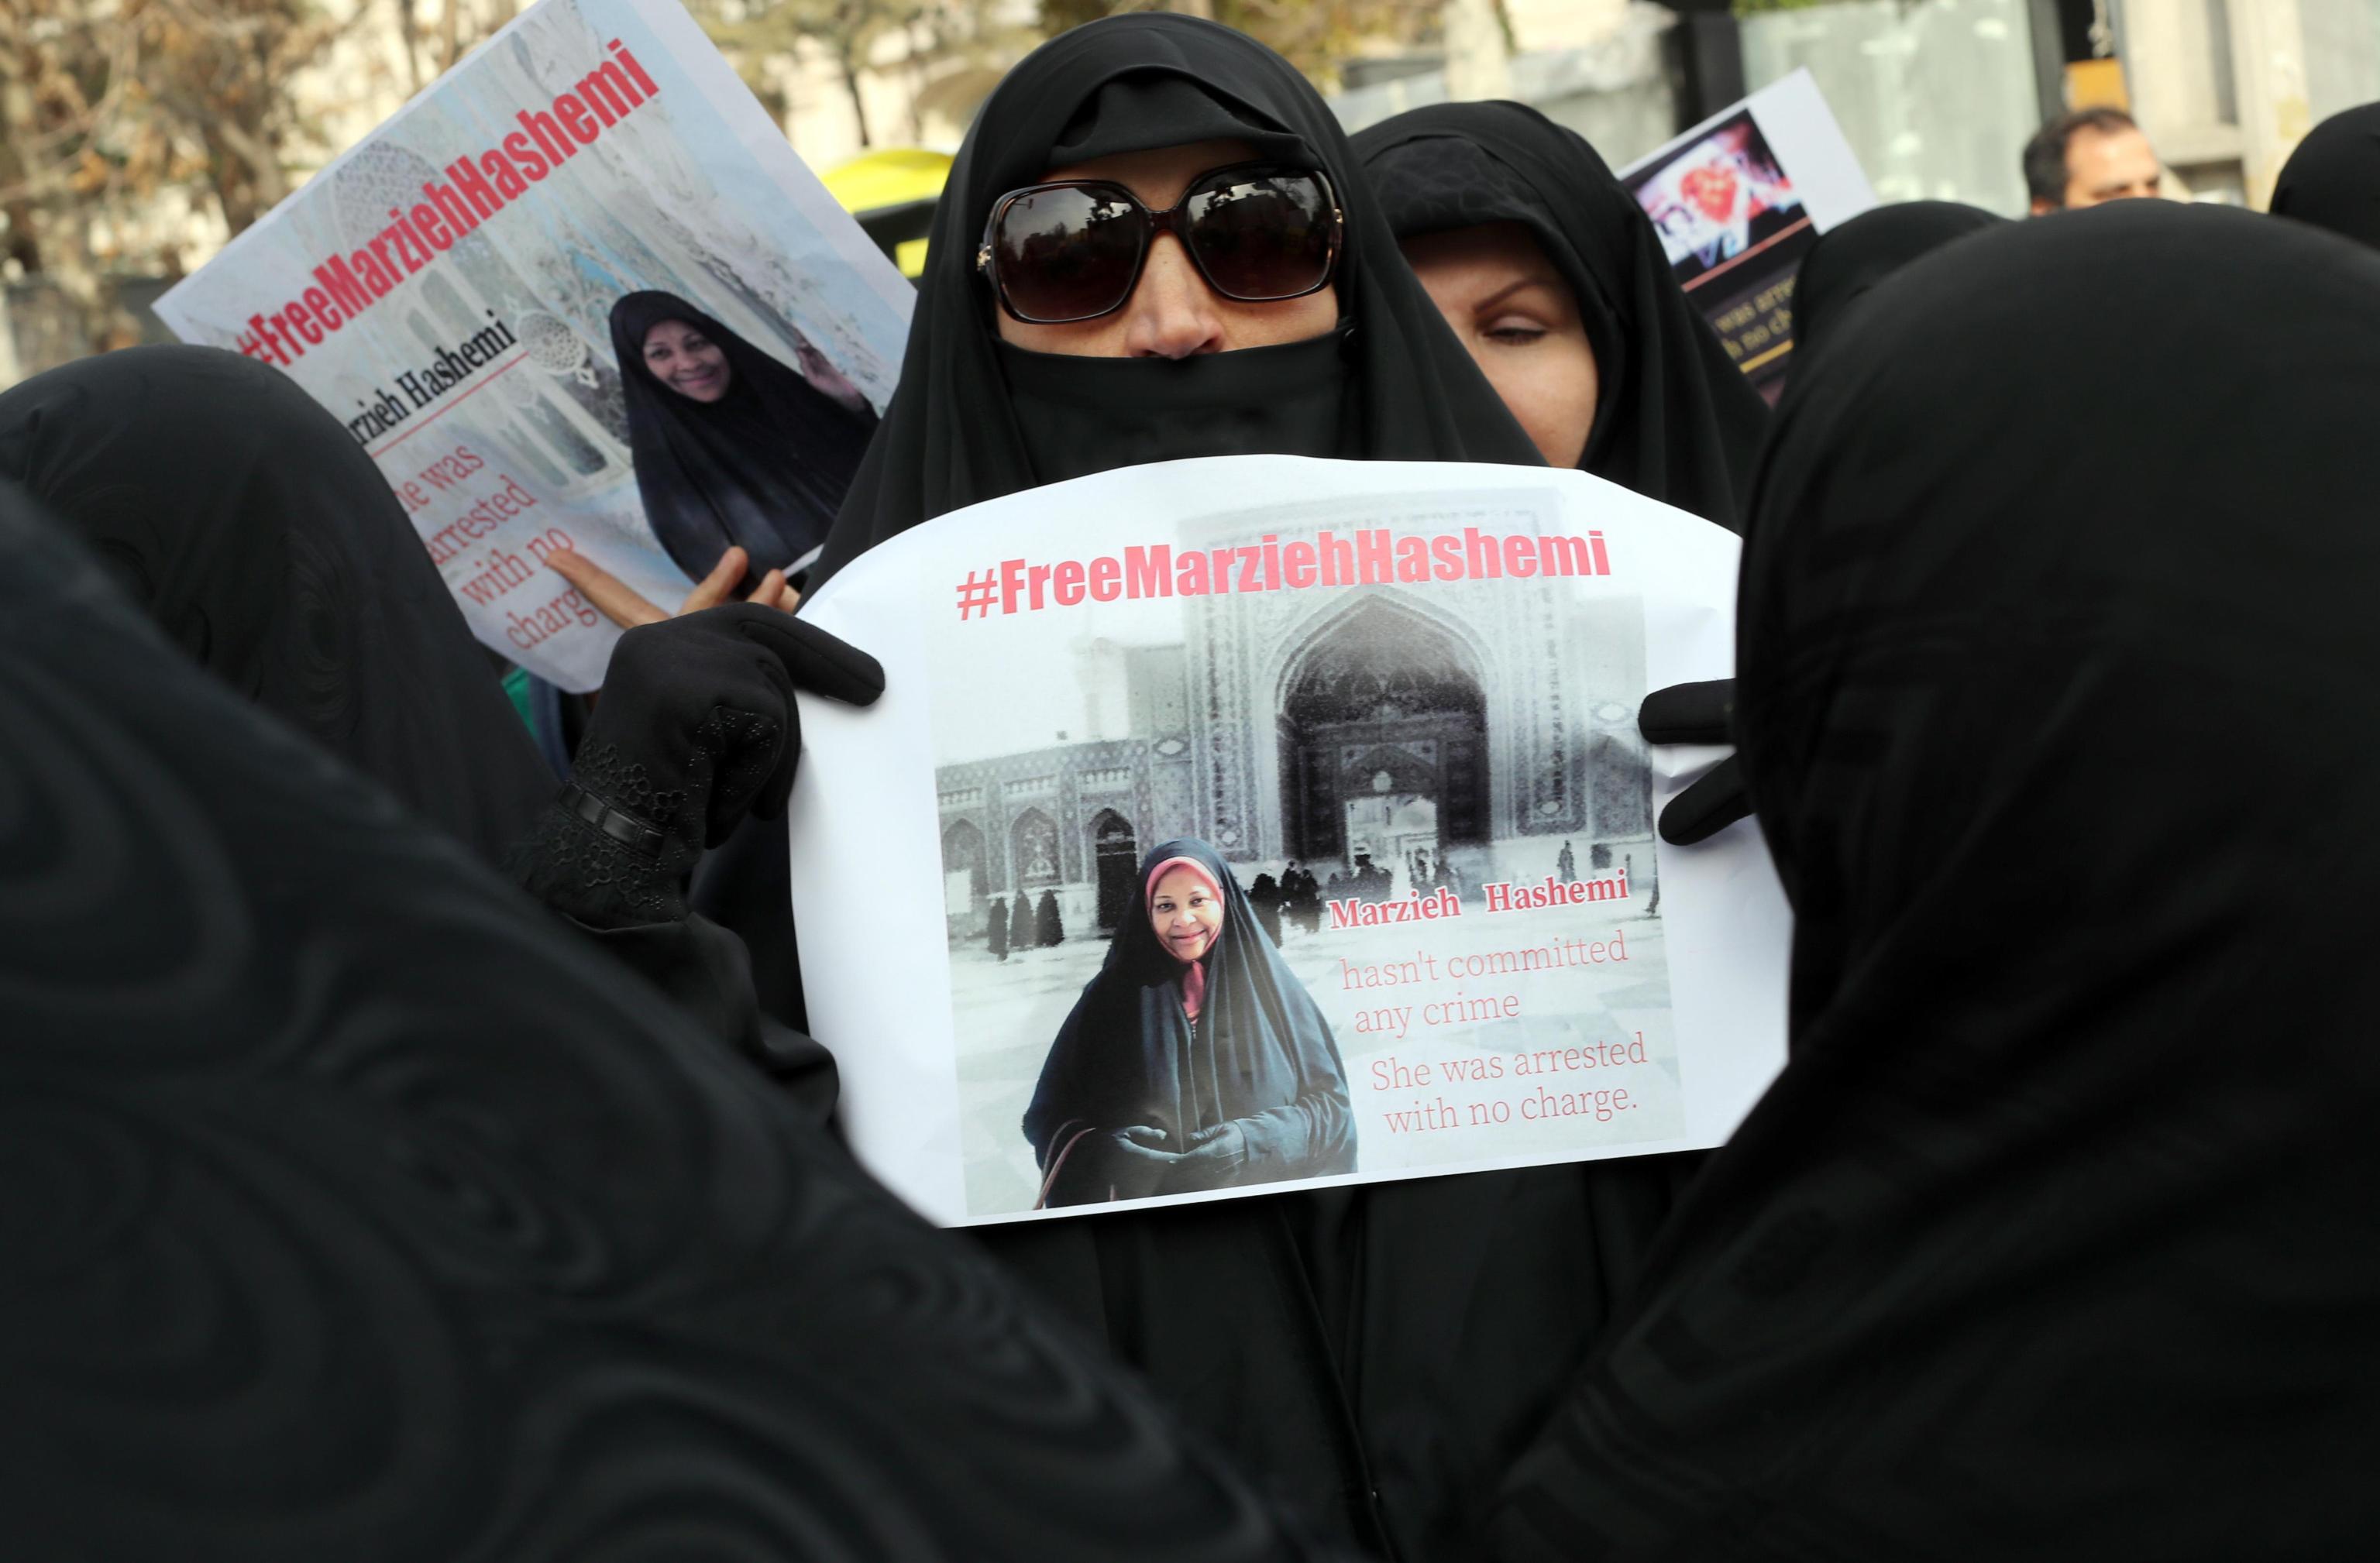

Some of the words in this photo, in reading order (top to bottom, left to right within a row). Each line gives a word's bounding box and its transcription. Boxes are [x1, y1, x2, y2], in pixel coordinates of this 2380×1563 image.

[236, 38, 659, 366] #FreeMarziehHashemi
[349, 388, 411, 446] rzieh
[395, 309, 517, 408] Hashemi
[418, 445, 484, 491] was
[425, 473, 538, 565] arrested
[461, 548, 535, 606] with
[526, 527, 575, 566] no
[957, 527, 1611, 620] #FreeMarziehHashemi
[506, 588, 598, 650] charg
[1329, 887, 1461, 929] Marzieh
[1484, 868, 1629, 913] Hashemi
[1339, 950, 1439, 991] hasn't
[1447, 929, 1629, 980] committed
[1354, 1006, 1413, 1039] any
[1423, 991, 1520, 1026] crime
[1371, 1056, 1431, 1091] She
[1439, 1054, 1504, 1084] was
[1515, 1032, 1648, 1077] arrested
[1383, 1097, 1460, 1135] with
[1468, 1100, 1511, 1126] no
[1521, 1086, 1638, 1122] charge.
